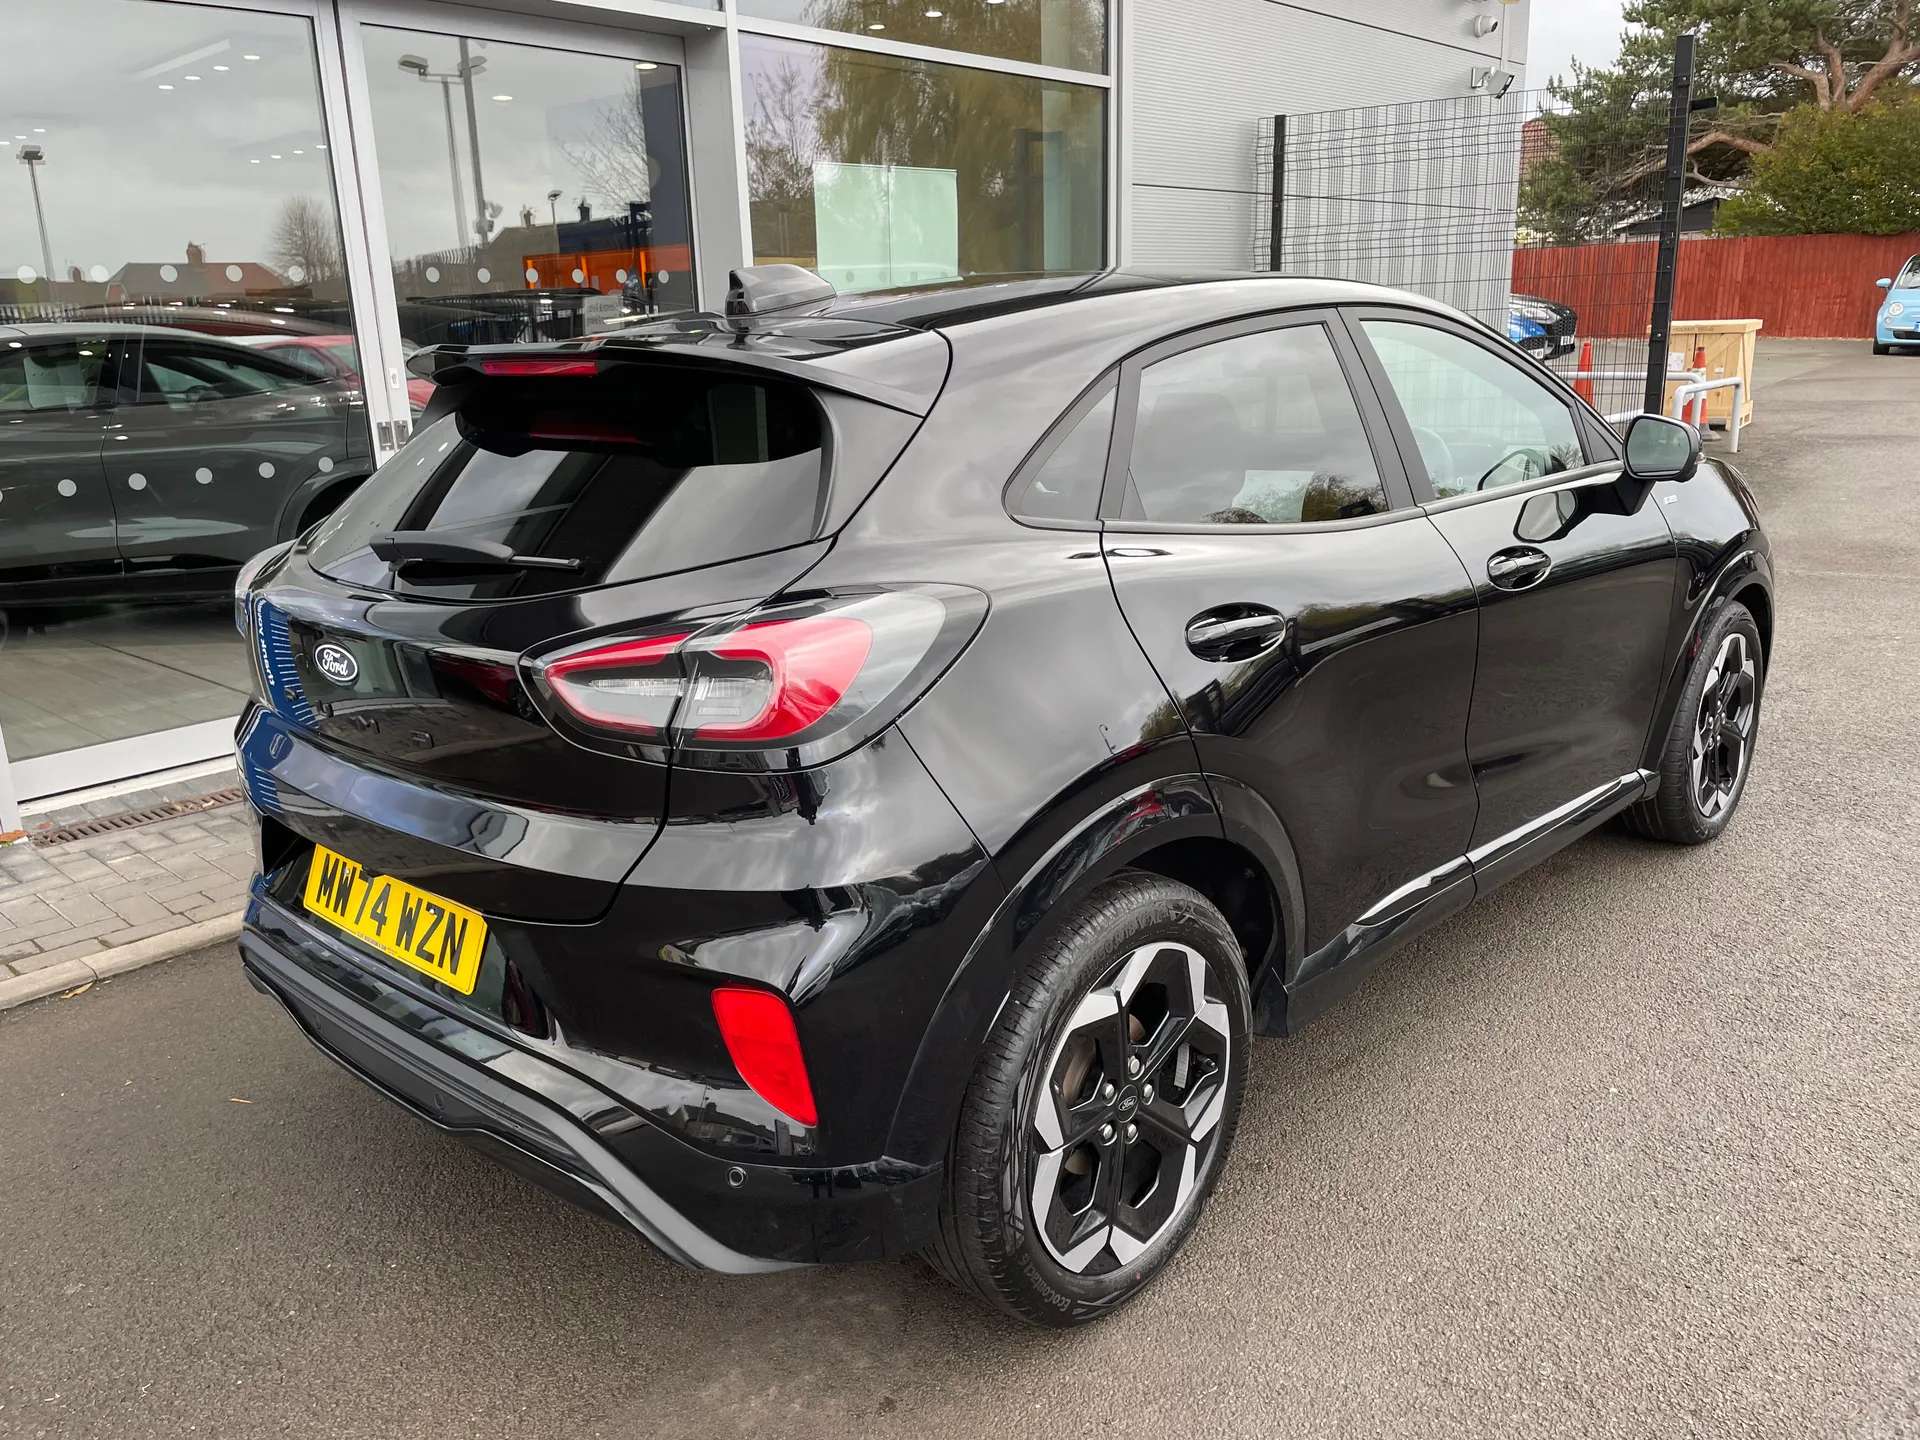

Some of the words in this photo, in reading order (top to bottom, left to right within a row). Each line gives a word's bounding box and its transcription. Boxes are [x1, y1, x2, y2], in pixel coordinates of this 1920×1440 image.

[322, 649, 348, 676] Ford
[316, 853, 357, 918] MW
[354, 869, 391, 937] 74
[395, 891, 468, 976] WZN
